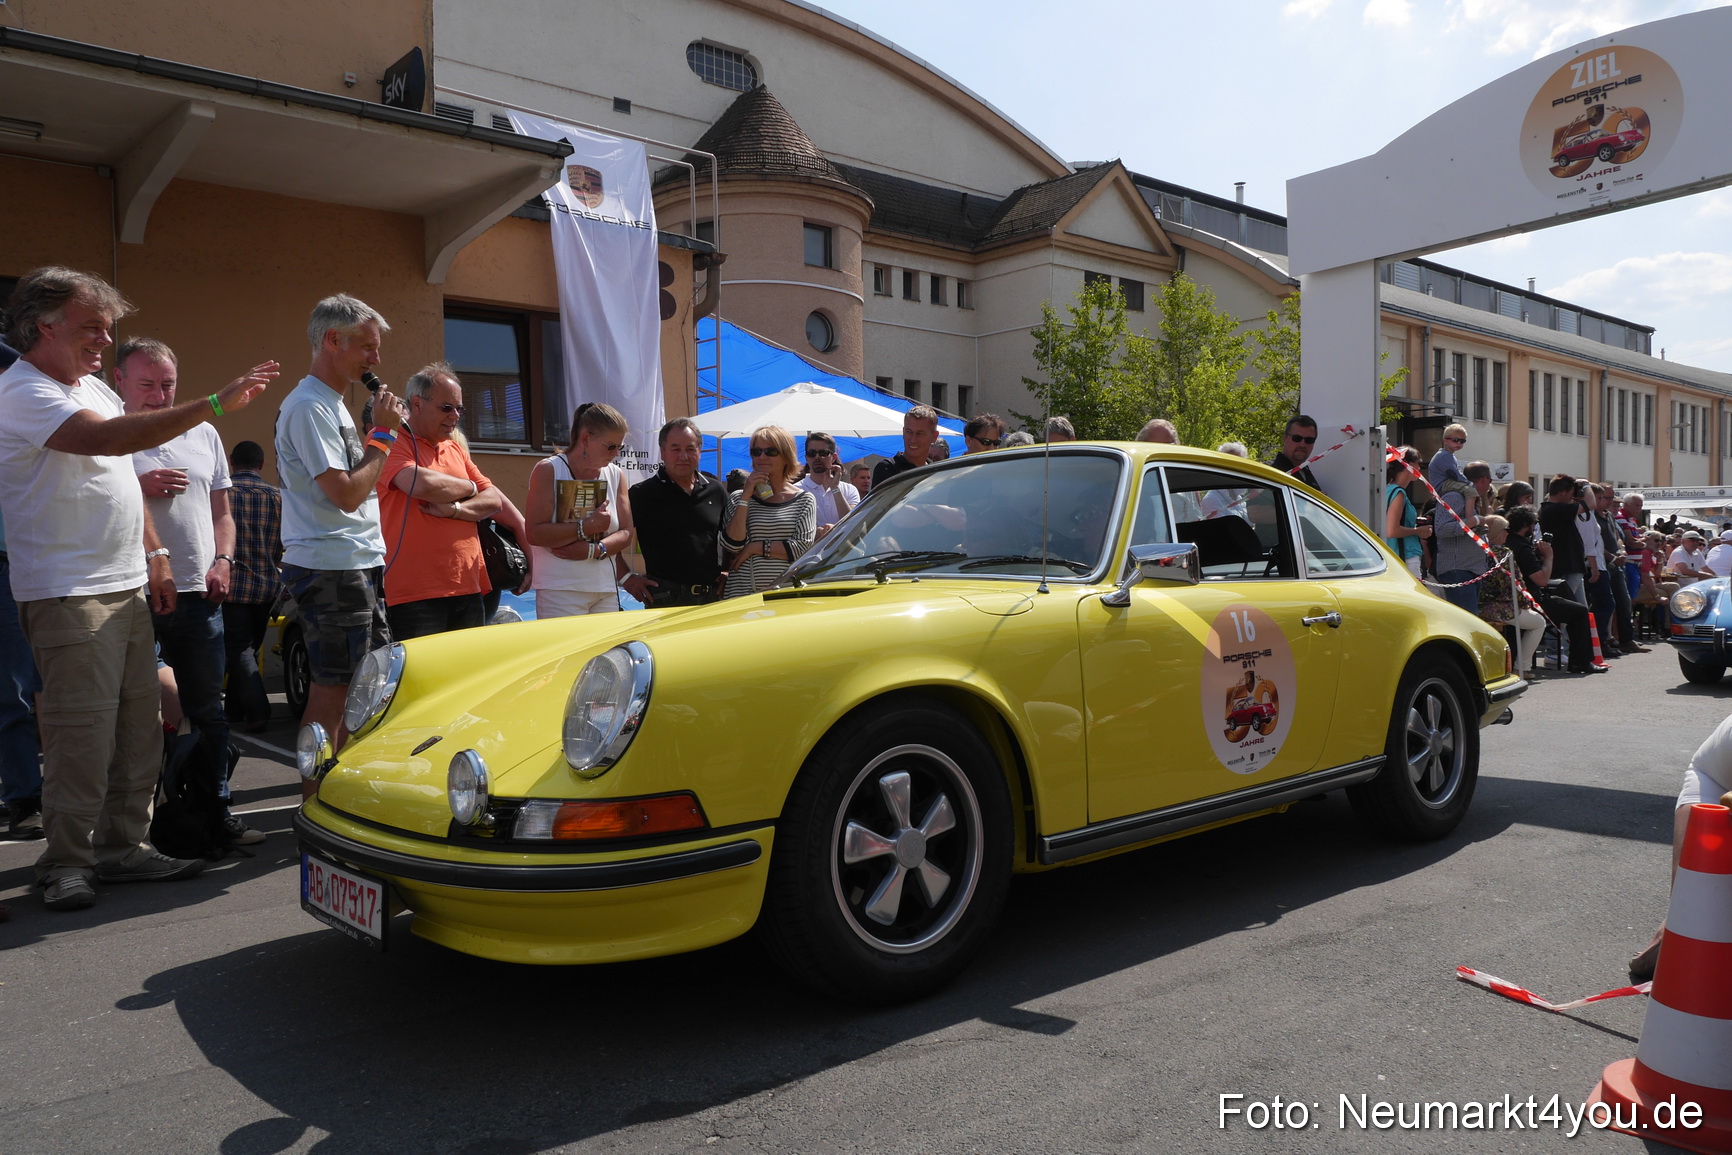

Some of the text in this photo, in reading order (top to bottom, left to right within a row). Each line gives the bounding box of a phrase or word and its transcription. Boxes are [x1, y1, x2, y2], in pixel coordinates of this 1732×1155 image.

[1570, 52, 1621, 89] ZIEL
[385, 72, 407, 104] sky
[1552, 74, 1642, 108] PORSCHE
[1584, 92, 1608, 105] 911
[1576, 165, 1621, 181] JAHRE
[545, 199, 652, 231] PORSCHE
[1230, 610, 1256, 643] 16
[1223, 648, 1272, 664] PORSCHE
[1242, 659, 1256, 669] 911
[1239, 737, 1265, 748] JAHRE
[308, 861, 324, 904] AB
[331, 873, 377, 929] 07517
